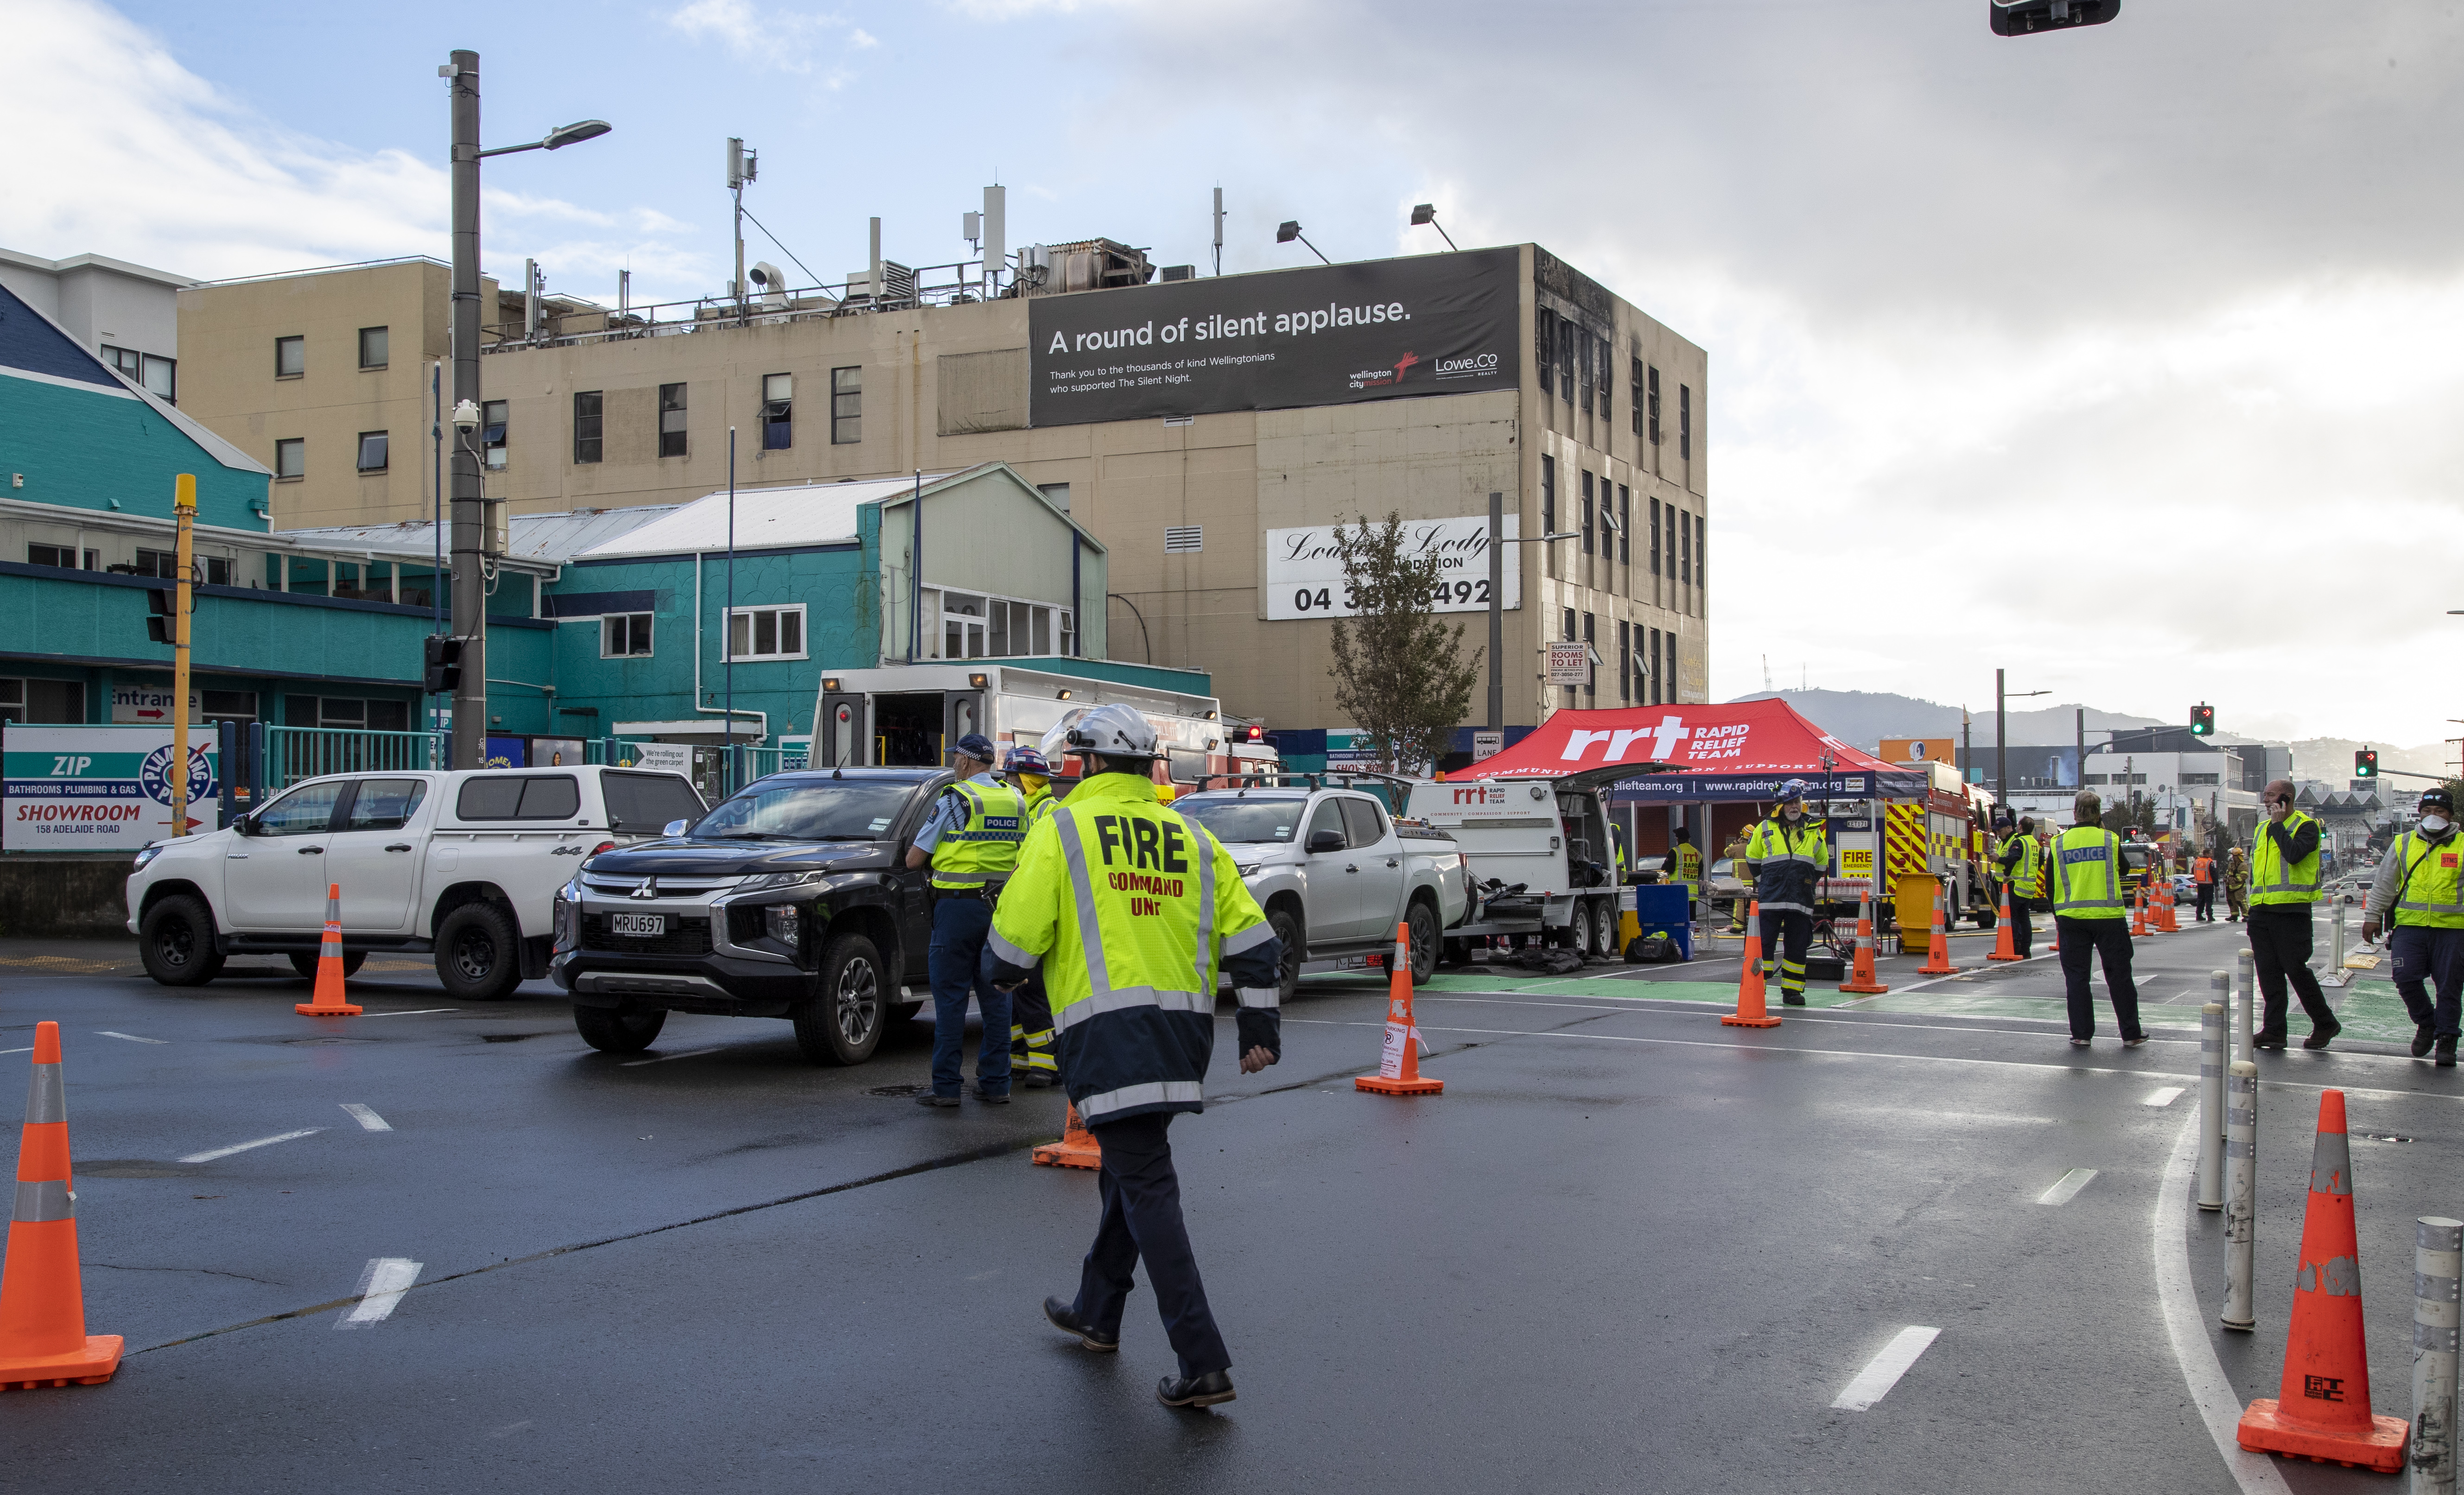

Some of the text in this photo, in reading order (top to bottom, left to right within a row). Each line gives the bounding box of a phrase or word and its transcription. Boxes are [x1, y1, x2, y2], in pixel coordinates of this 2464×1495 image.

[1048, 302, 1410, 354] A round of silent applause.
[1050, 370, 1076, 380] Thank
[1079, 369, 1095, 379] you
[1109, 365, 1124, 374] the
[1127, 361, 1172, 372] thousands
[1175, 360, 1184, 369] of
[1187, 358, 1206, 368] kind
[1210, 353, 1275, 366] Wellingtonians
[1350, 370, 1391, 380] wellington
[1050, 385, 1068, 393] who
[1071, 380, 1115, 393] supported
[1138, 376, 1162, 386] Silent
[1166, 374, 1192, 385] Night.
[1407, 524, 1489, 560] Lodg
[1295, 588, 1331, 611] 04
[113, 689, 197, 708] ntrane
[1155, 725, 1168, 736] CALL
[1561, 716, 1690, 761] rrt
[1695, 724, 1750, 739] RAPID
[1691, 736, 1747, 751] RELIEF
[1688, 748, 1742, 760] TEAM
[51, 756, 91, 775] ZIP
[1454, 786, 1486, 804] rrt
[17, 805, 140, 821] SHOWROOM
[36, 825, 120, 833] 158 ADELAIDE ROAD
[1094, 815, 1188, 874] FIRE
[1683, 852, 1698, 862] rrt
[1844, 852, 1872, 862] FIRE
[2065, 848, 2103, 862] POLICE
[1108, 872, 1183, 897] COMMAND
[615, 916, 662, 932] MRU697
